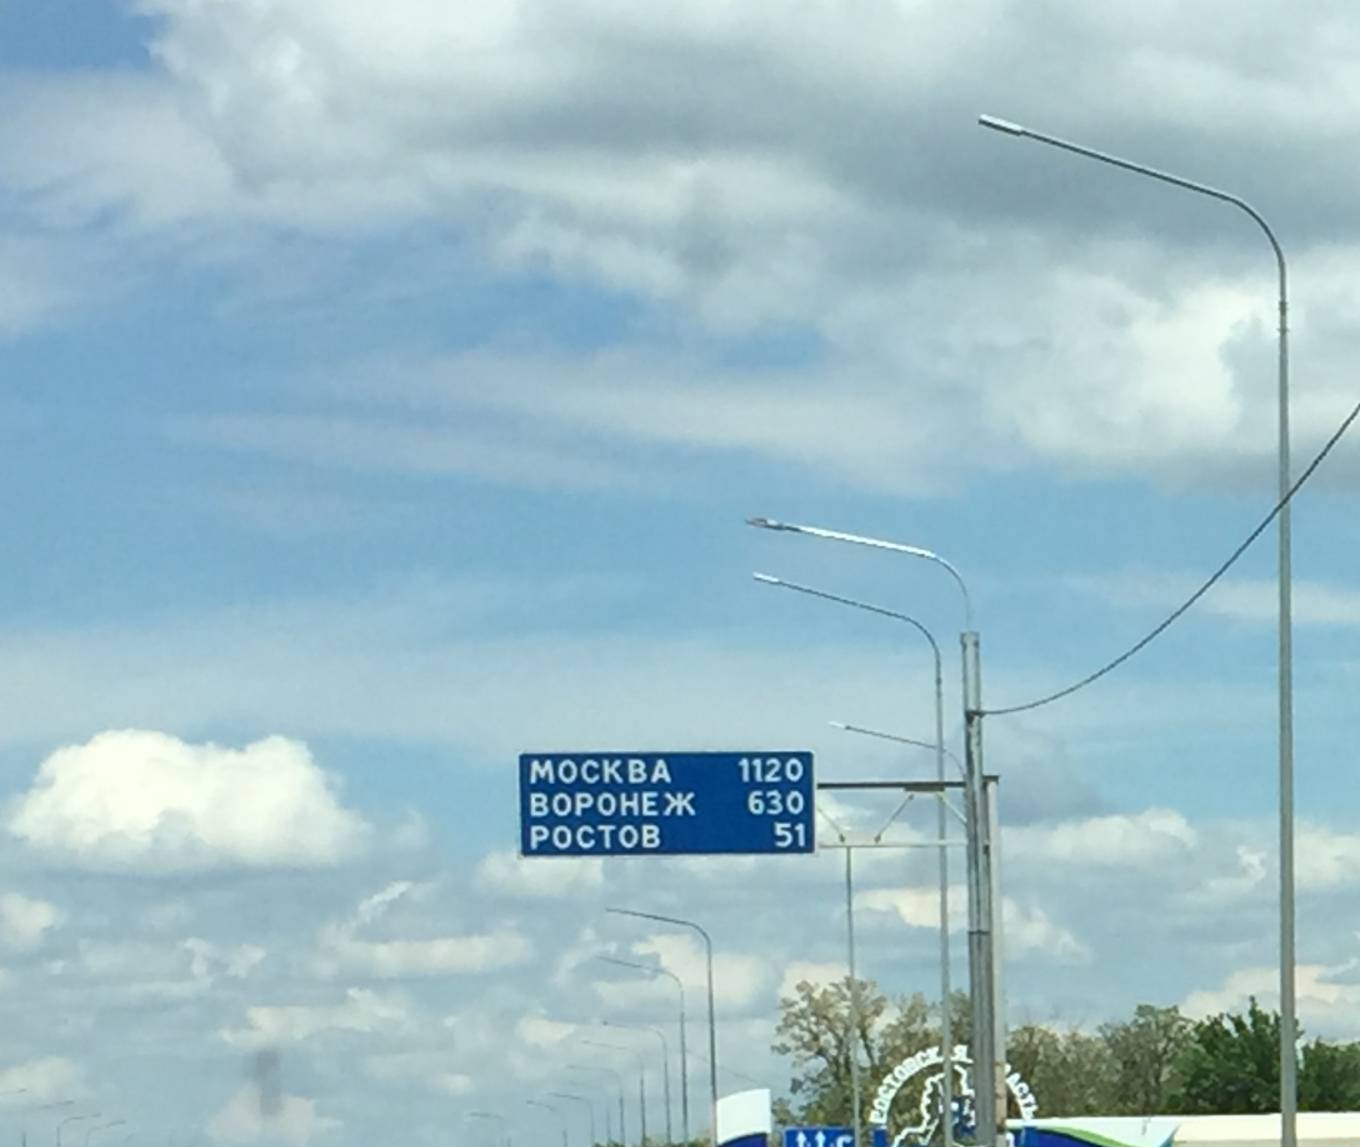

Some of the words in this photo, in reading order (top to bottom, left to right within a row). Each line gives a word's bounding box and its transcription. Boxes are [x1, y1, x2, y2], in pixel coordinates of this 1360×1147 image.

[529, 759, 672, 784] МОСКВА
[738, 758, 804, 783] 1120
[529, 792, 696, 817] ВОРОНЕЖ
[747, 790, 804, 816] 630
[530, 824, 661, 849] РОСТОВ
[774, 822, 806, 847] 51
[868, 1044, 970, 1123] РОСТОВСКЯ
